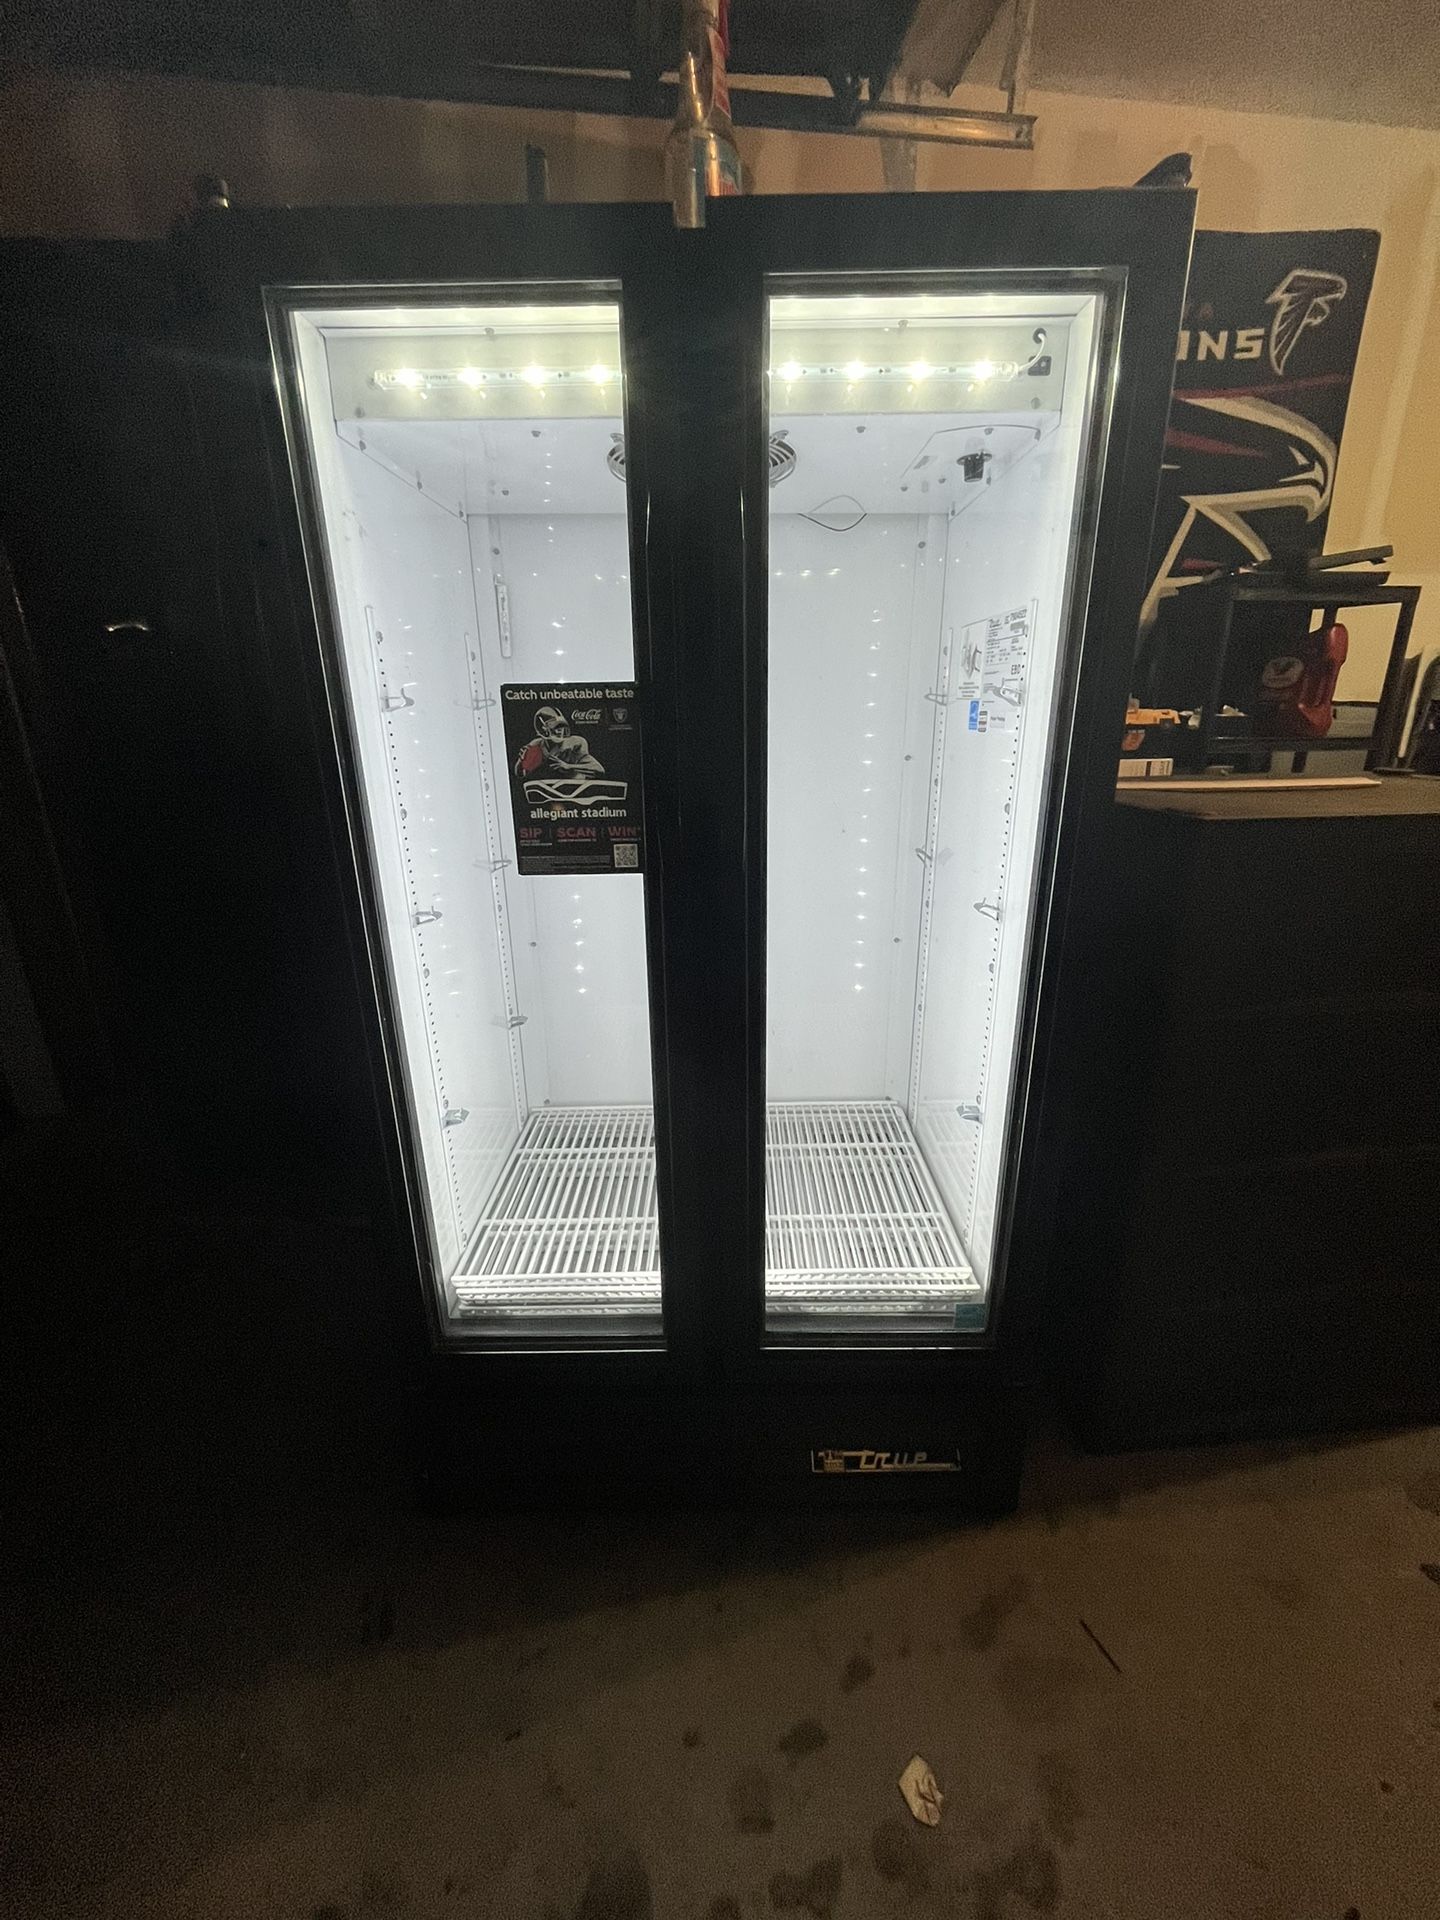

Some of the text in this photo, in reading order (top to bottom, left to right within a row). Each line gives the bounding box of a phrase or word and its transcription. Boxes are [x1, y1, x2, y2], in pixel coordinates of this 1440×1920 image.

[505, 688, 634, 700] Catch unbeatable taste
[530, 806, 627, 821] allegiant stadium
[520, 828, 542, 838] SIP
[556, 827, 596, 838] SCAN
